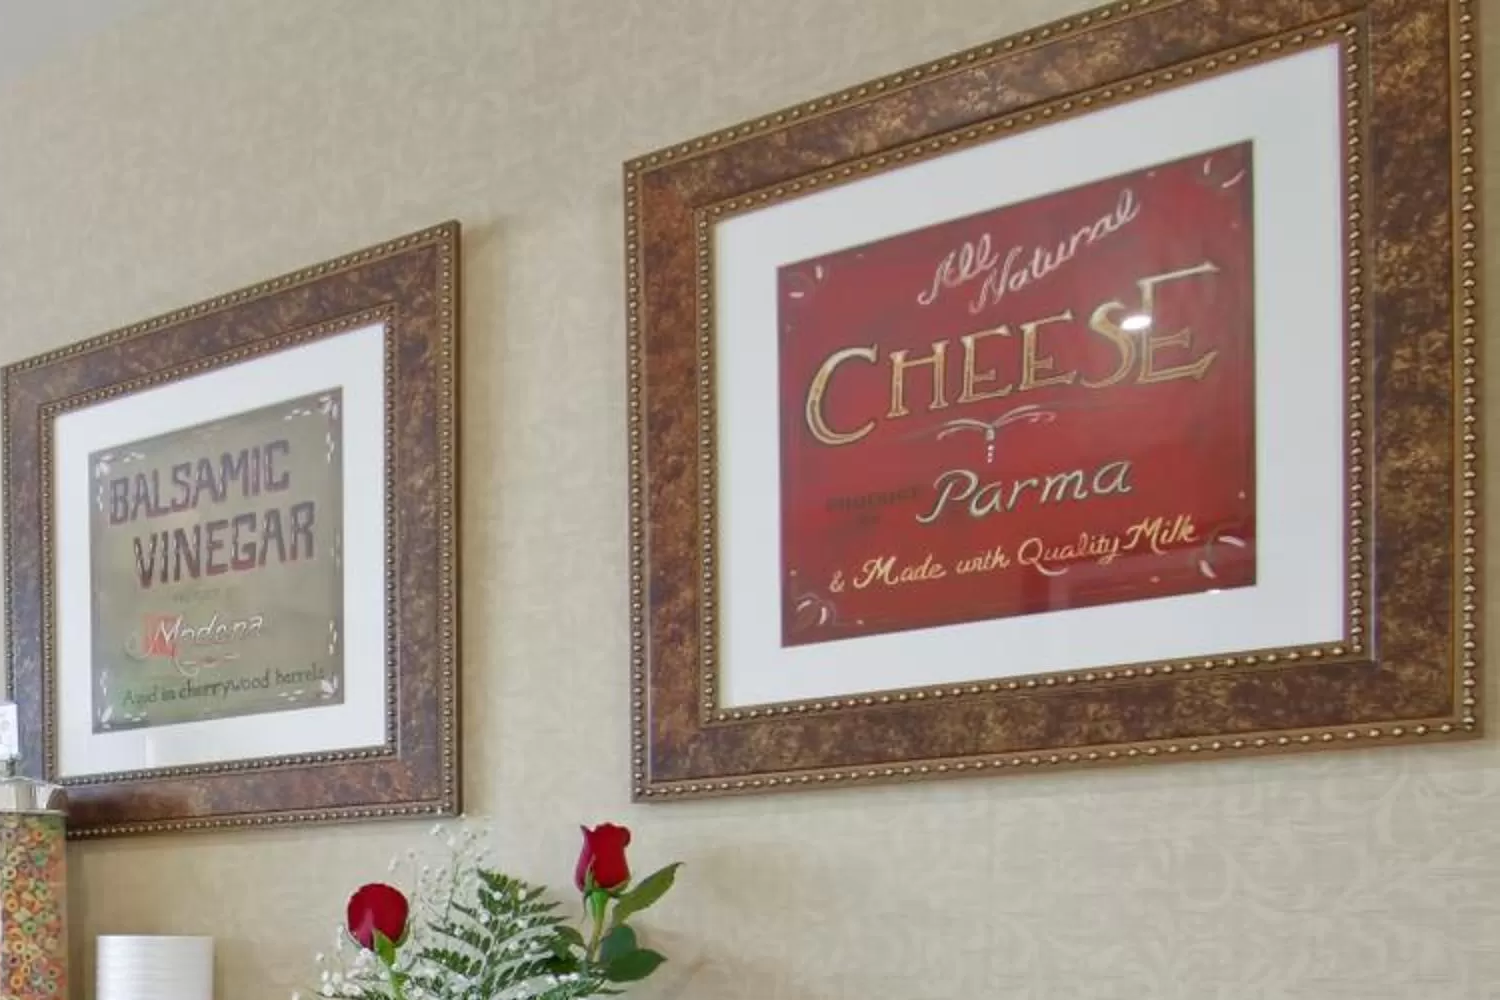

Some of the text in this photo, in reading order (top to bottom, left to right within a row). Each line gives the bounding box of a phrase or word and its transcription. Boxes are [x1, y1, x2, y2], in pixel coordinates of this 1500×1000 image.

[917, 233, 1001, 306] All
[969, 187, 1141, 314] Natural
[804, 259, 1221, 446] CHEESE
[107, 438, 291, 527] BALSAMIC
[915, 460, 1133, 524] Parma
[132, 500, 316, 590] VINEGAR
[853, 556, 946, 589] Made
[956, 545, 1011, 576] with
[1016, 534, 1122, 577] Quality
[1122, 512, 1199, 555] Milk
[178, 667, 270, 701] cherrywood
